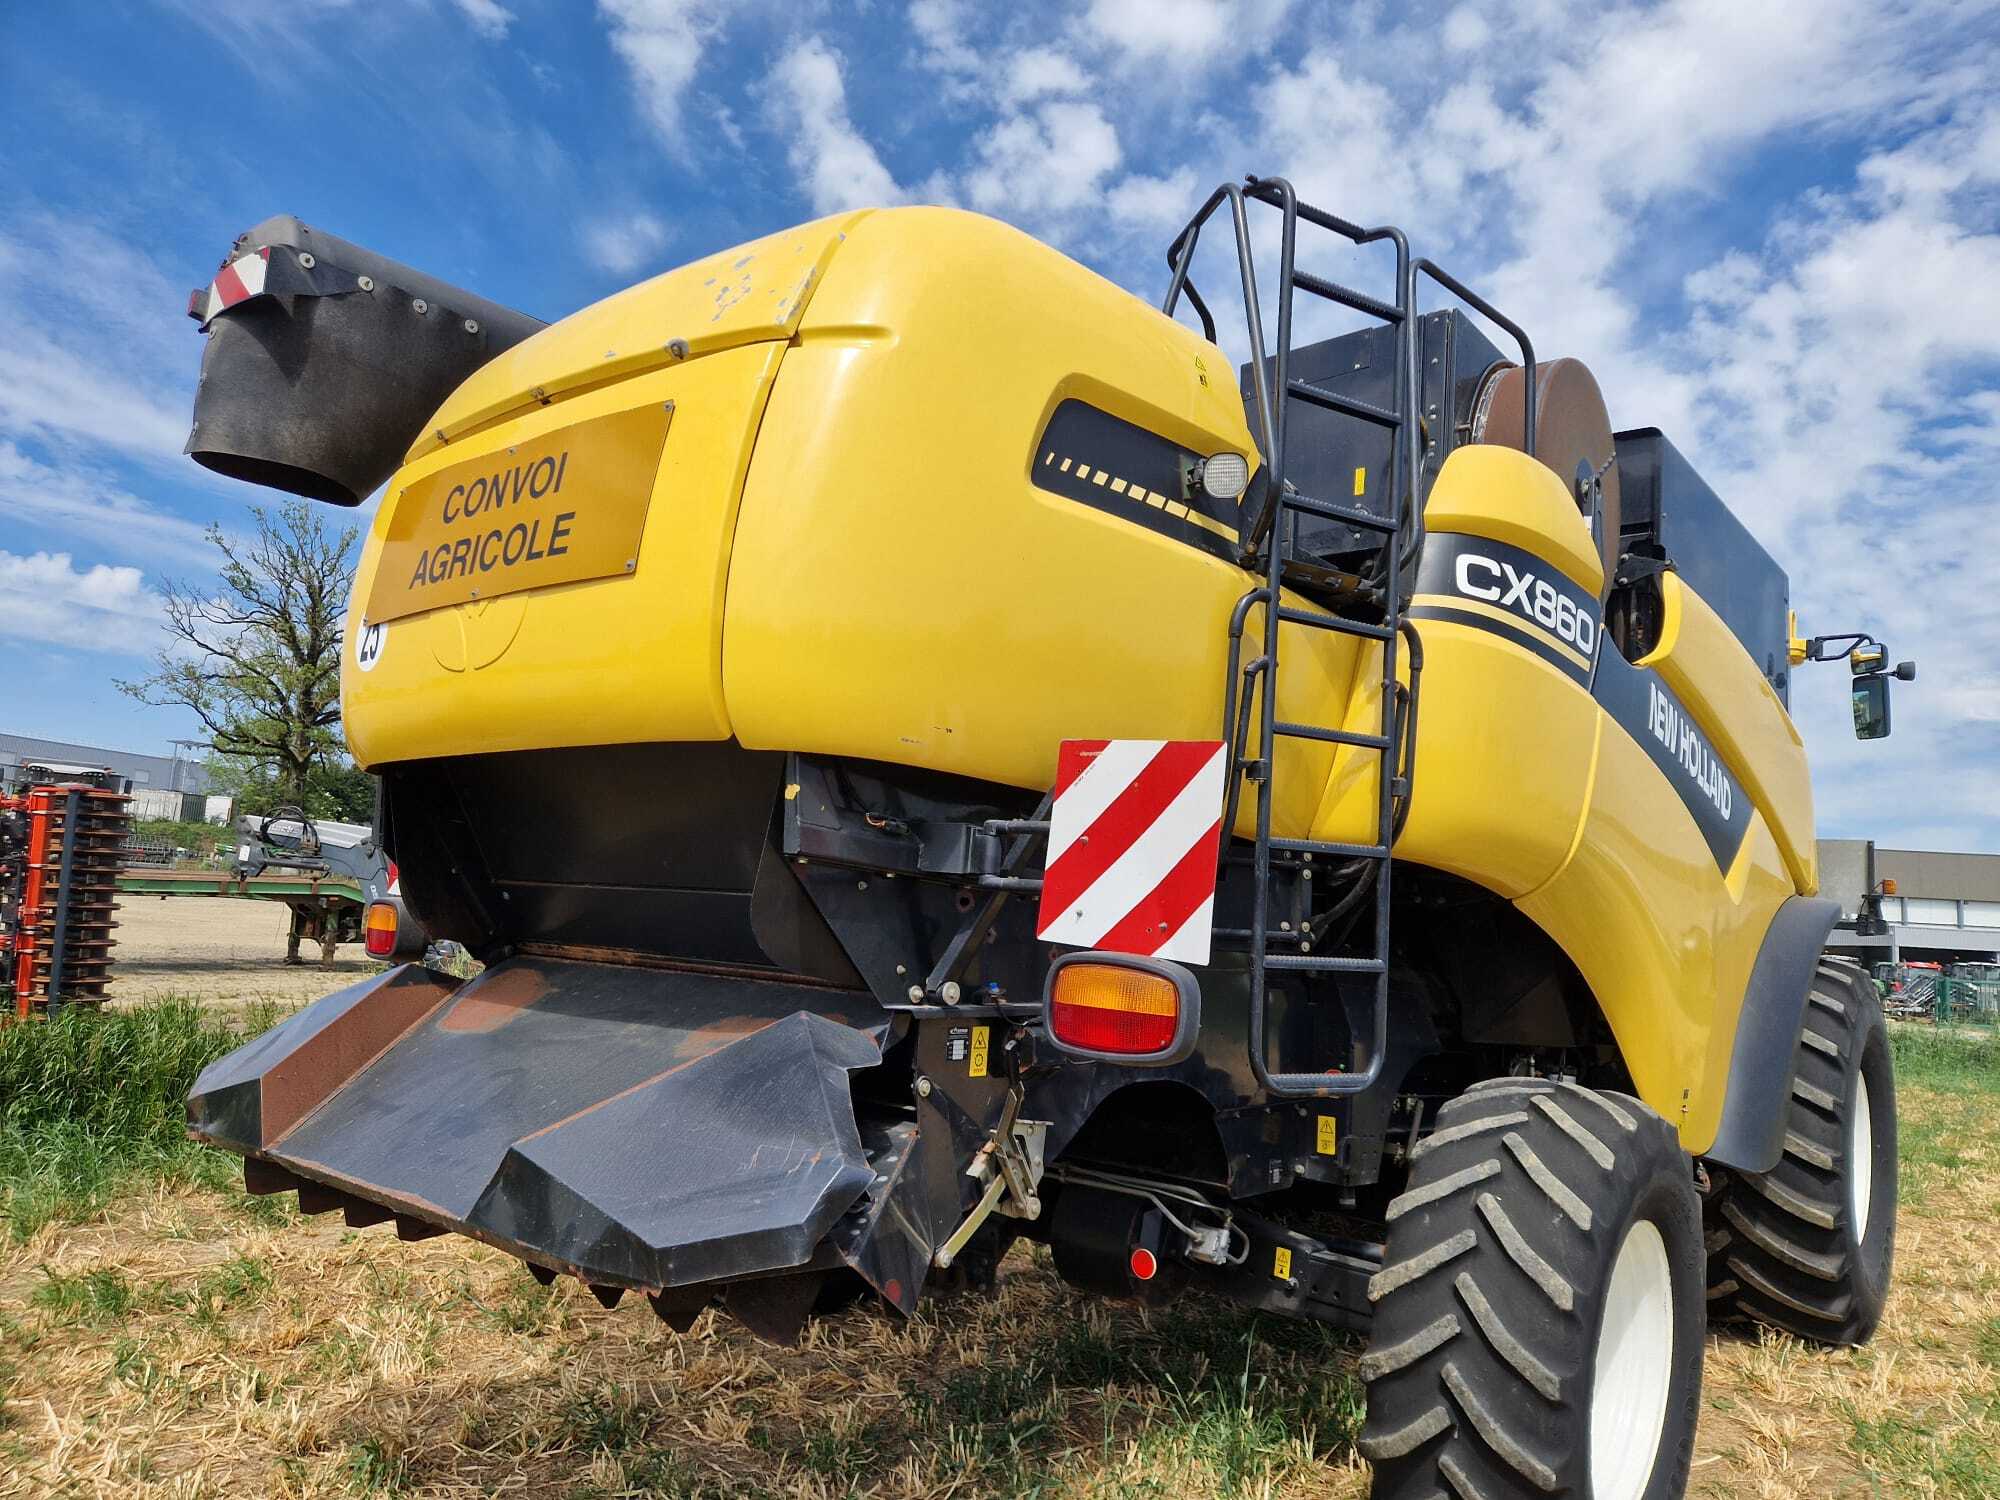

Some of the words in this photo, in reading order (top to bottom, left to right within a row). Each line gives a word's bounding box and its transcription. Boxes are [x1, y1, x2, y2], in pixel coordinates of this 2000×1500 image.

[443, 451, 569, 524] CONVOI
[409, 511, 576, 590] AGRICOLE
[1455, 553, 1595, 656] CX860
[1648, 681, 1678, 755] NEW
[1679, 717, 1732, 821] HOLLAND
